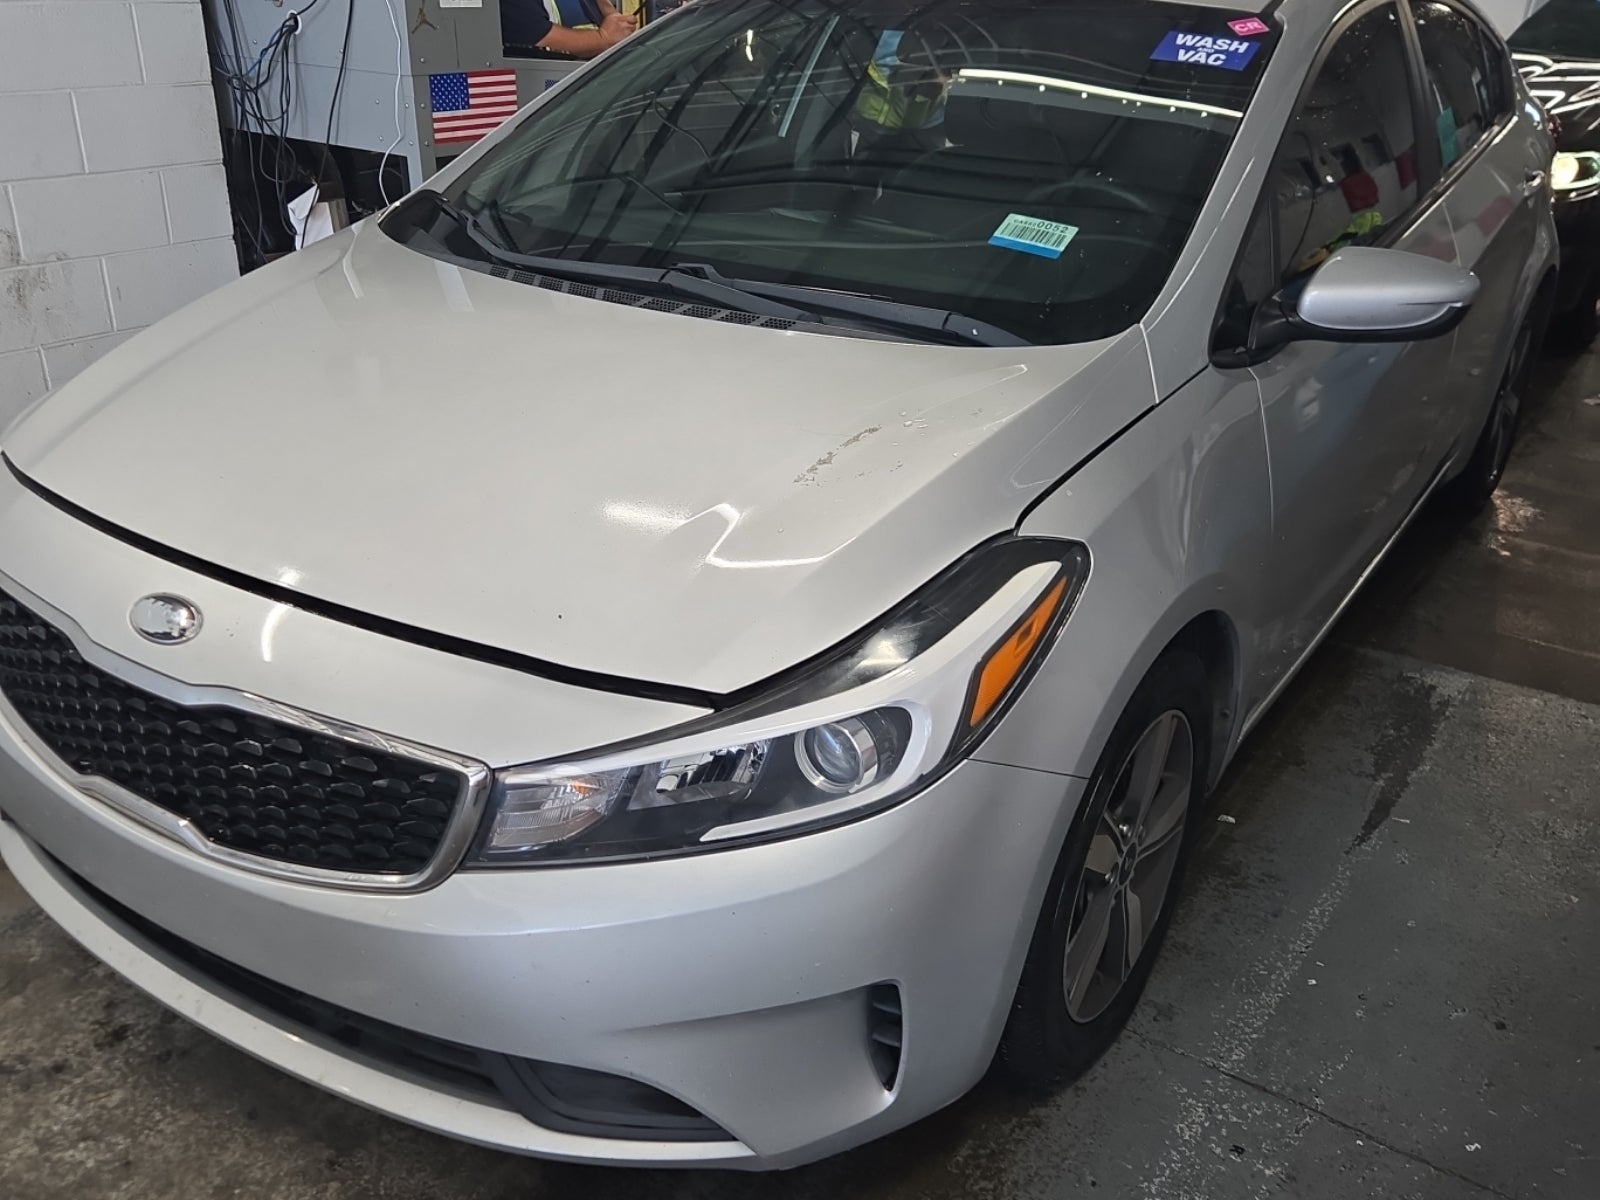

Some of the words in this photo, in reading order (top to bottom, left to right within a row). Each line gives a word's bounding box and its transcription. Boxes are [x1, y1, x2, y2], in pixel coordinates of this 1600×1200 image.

[1234, 21, 1263, 32] CR
[1175, 33, 1250, 53] WASH
[1177, 49, 1227, 66] VAC
[1036, 221, 1069, 234] 0052
